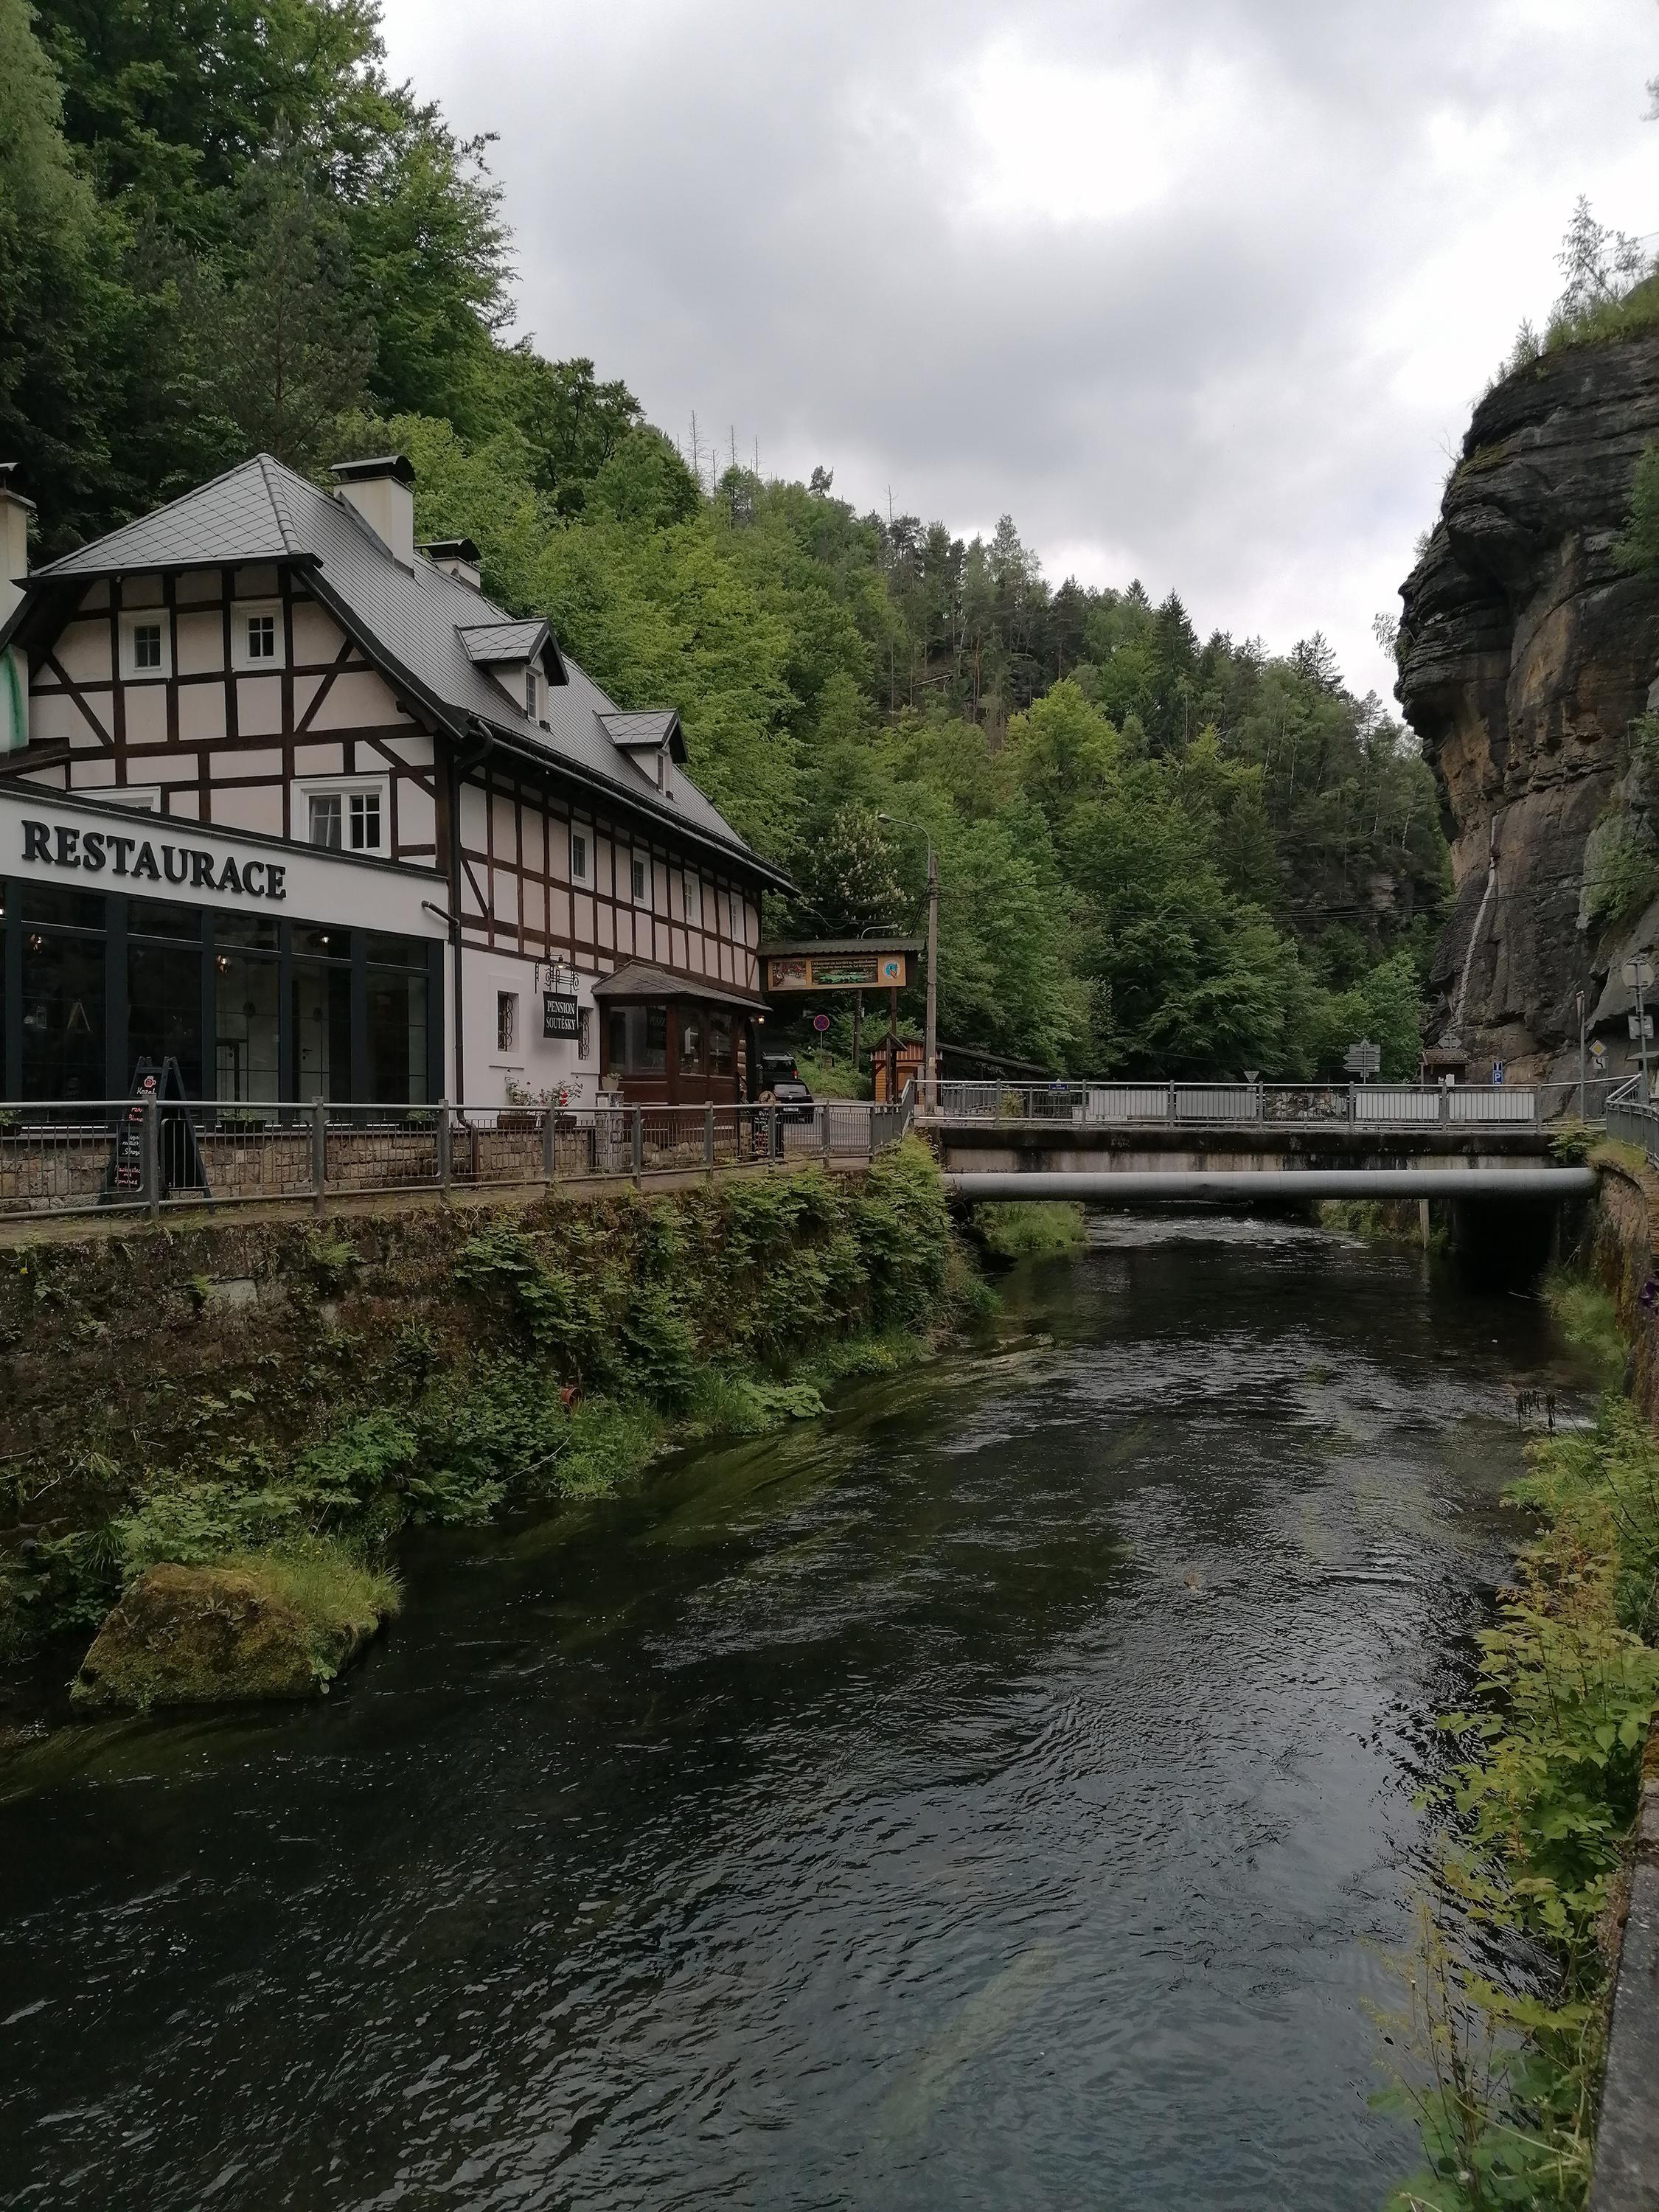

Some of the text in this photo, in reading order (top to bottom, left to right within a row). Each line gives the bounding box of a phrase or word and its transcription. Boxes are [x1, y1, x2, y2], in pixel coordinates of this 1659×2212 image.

[21, 819, 287, 900] RESTAURACE
[546, 1000, 575, 1015] PENSION
[546, 1016, 576, 1030] SOUTĚSKY
[1495, 1073, 1501, 1082] P
